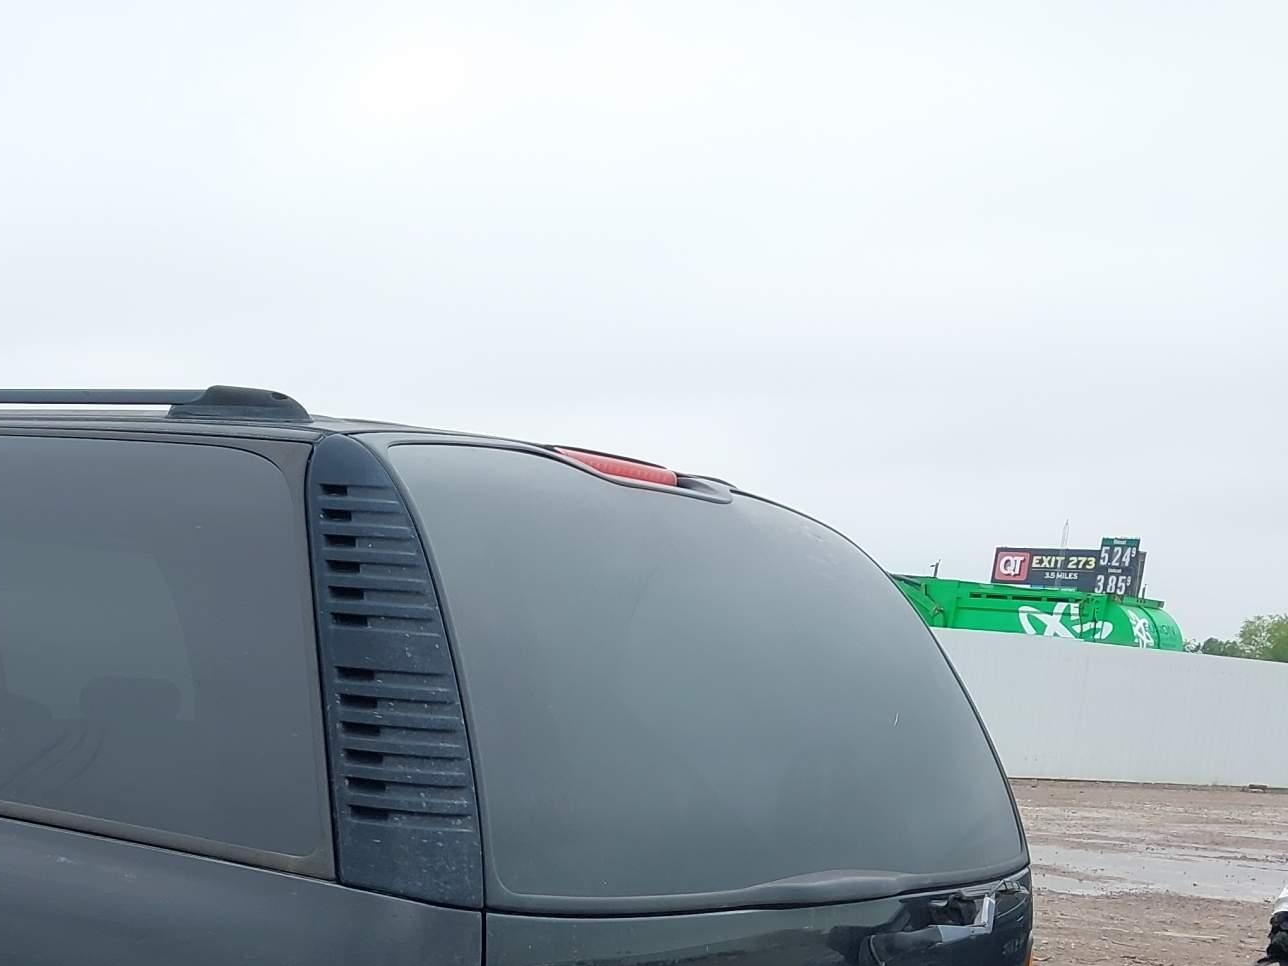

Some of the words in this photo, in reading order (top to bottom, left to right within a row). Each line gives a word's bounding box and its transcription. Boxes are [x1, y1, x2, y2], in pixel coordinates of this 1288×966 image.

[999, 555, 1025, 576] QT
[1031, 556, 1066, 568] EXIT
[1067, 556, 1096, 569] 273
[1056, 572, 1078, 580] MILES
